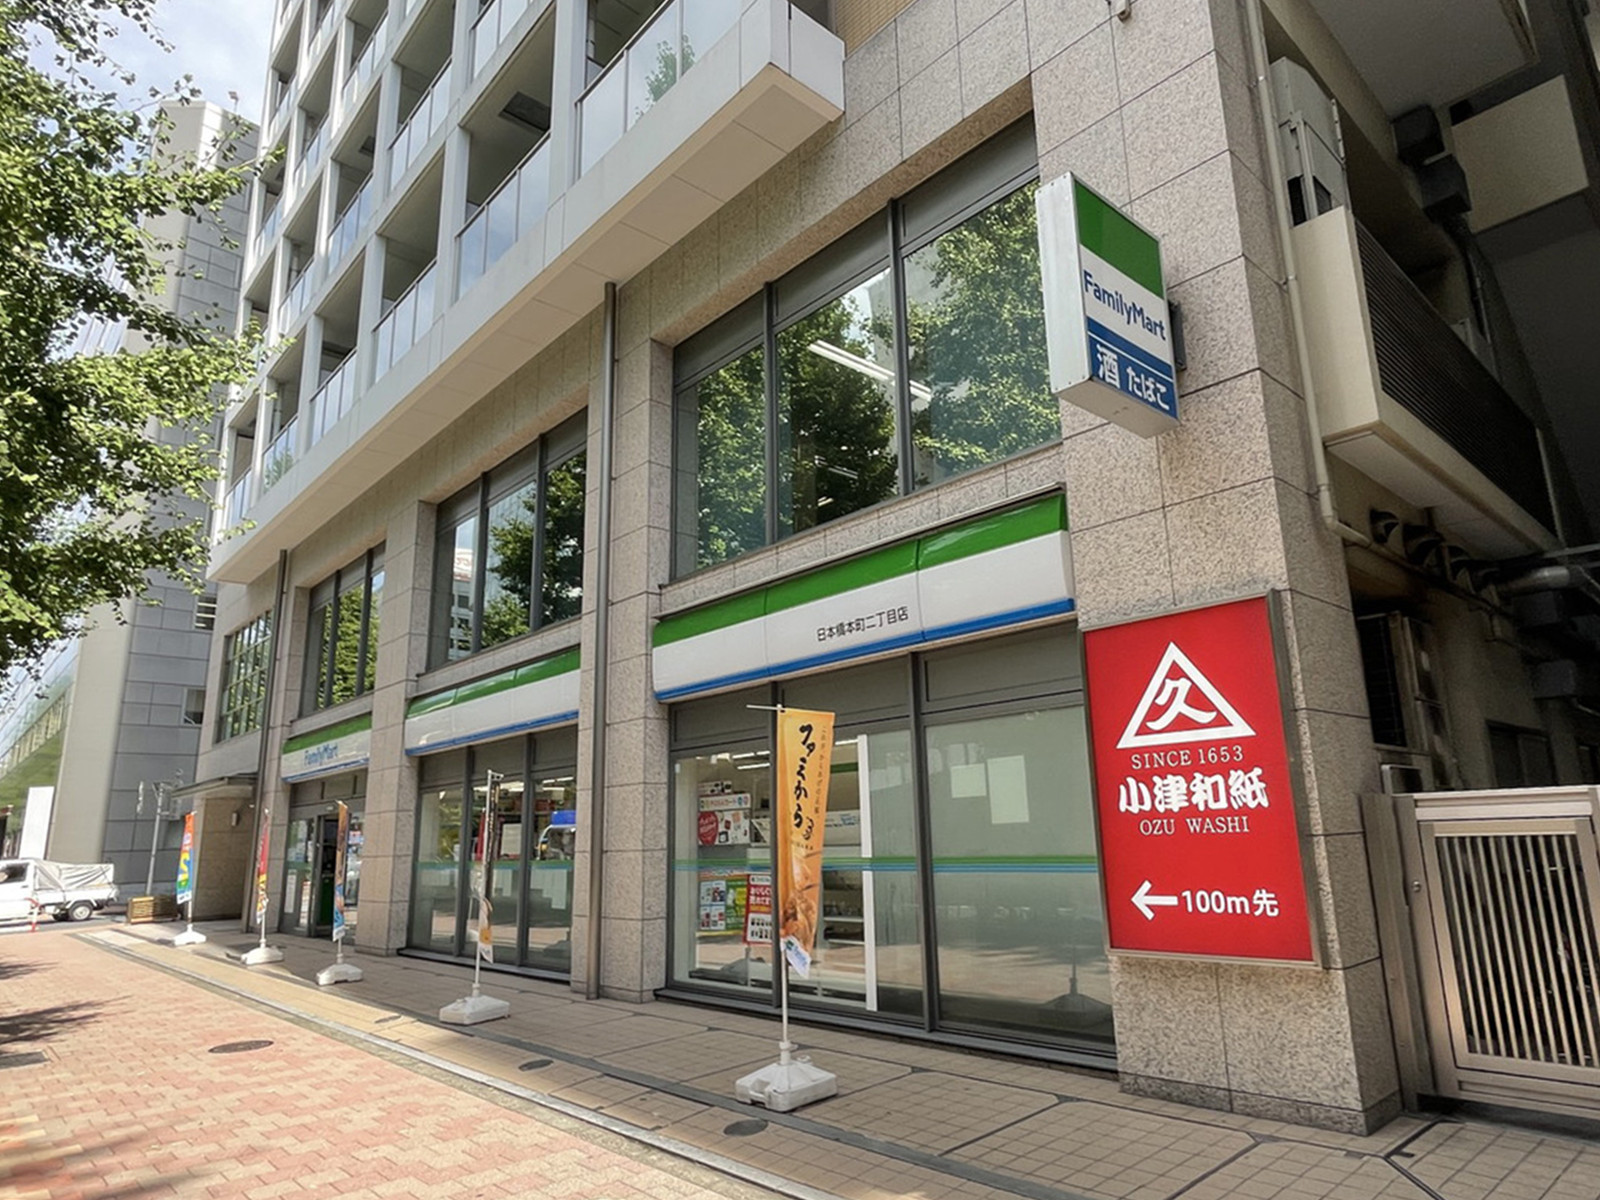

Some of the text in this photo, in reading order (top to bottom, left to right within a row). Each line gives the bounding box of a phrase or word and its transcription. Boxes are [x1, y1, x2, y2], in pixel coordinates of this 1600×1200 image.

[1082, 270, 1167, 341] FamilyMart
[1096, 344, 1170, 410] 酒 たばこ
[816, 605, 909, 642] 日本橋本町二丁目店
[1145, 677, 1218, 731] 久
[1131, 745, 1244, 770] SINCE 1653
[1118, 767, 1270, 814] 小津和紙
[1139, 815, 1250, 836] OZU WASHI
[1180, 888, 1280, 918] 100m先
